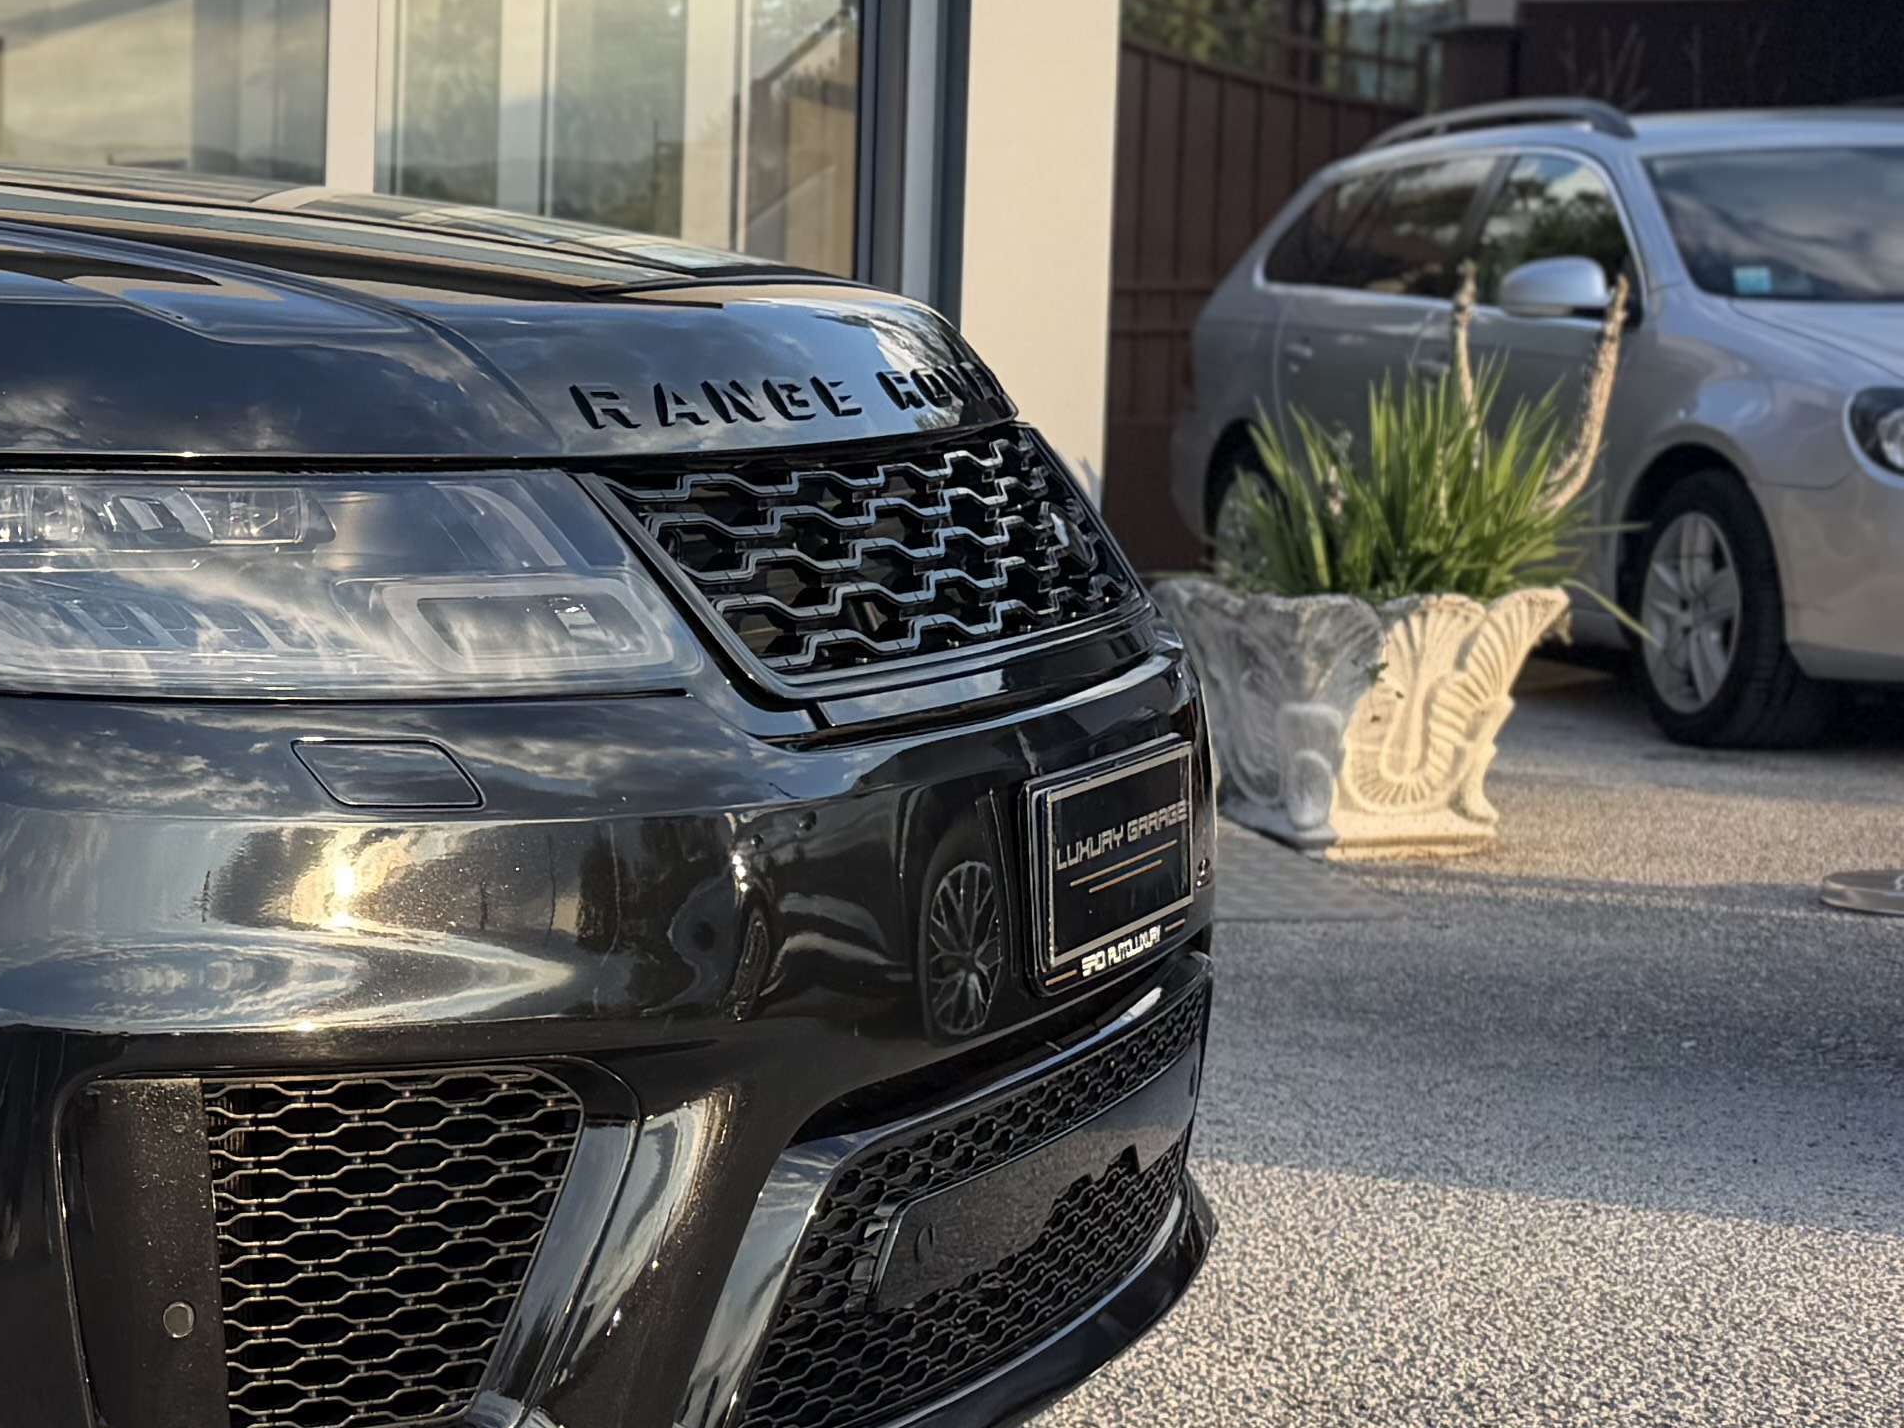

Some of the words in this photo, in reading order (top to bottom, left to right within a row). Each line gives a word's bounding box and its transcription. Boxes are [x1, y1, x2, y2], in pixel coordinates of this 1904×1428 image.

[569, 376, 863, 430] RANGE
[1055, 824, 1124, 870] LUXURY
[1127, 799, 1188, 842] GARAGE
